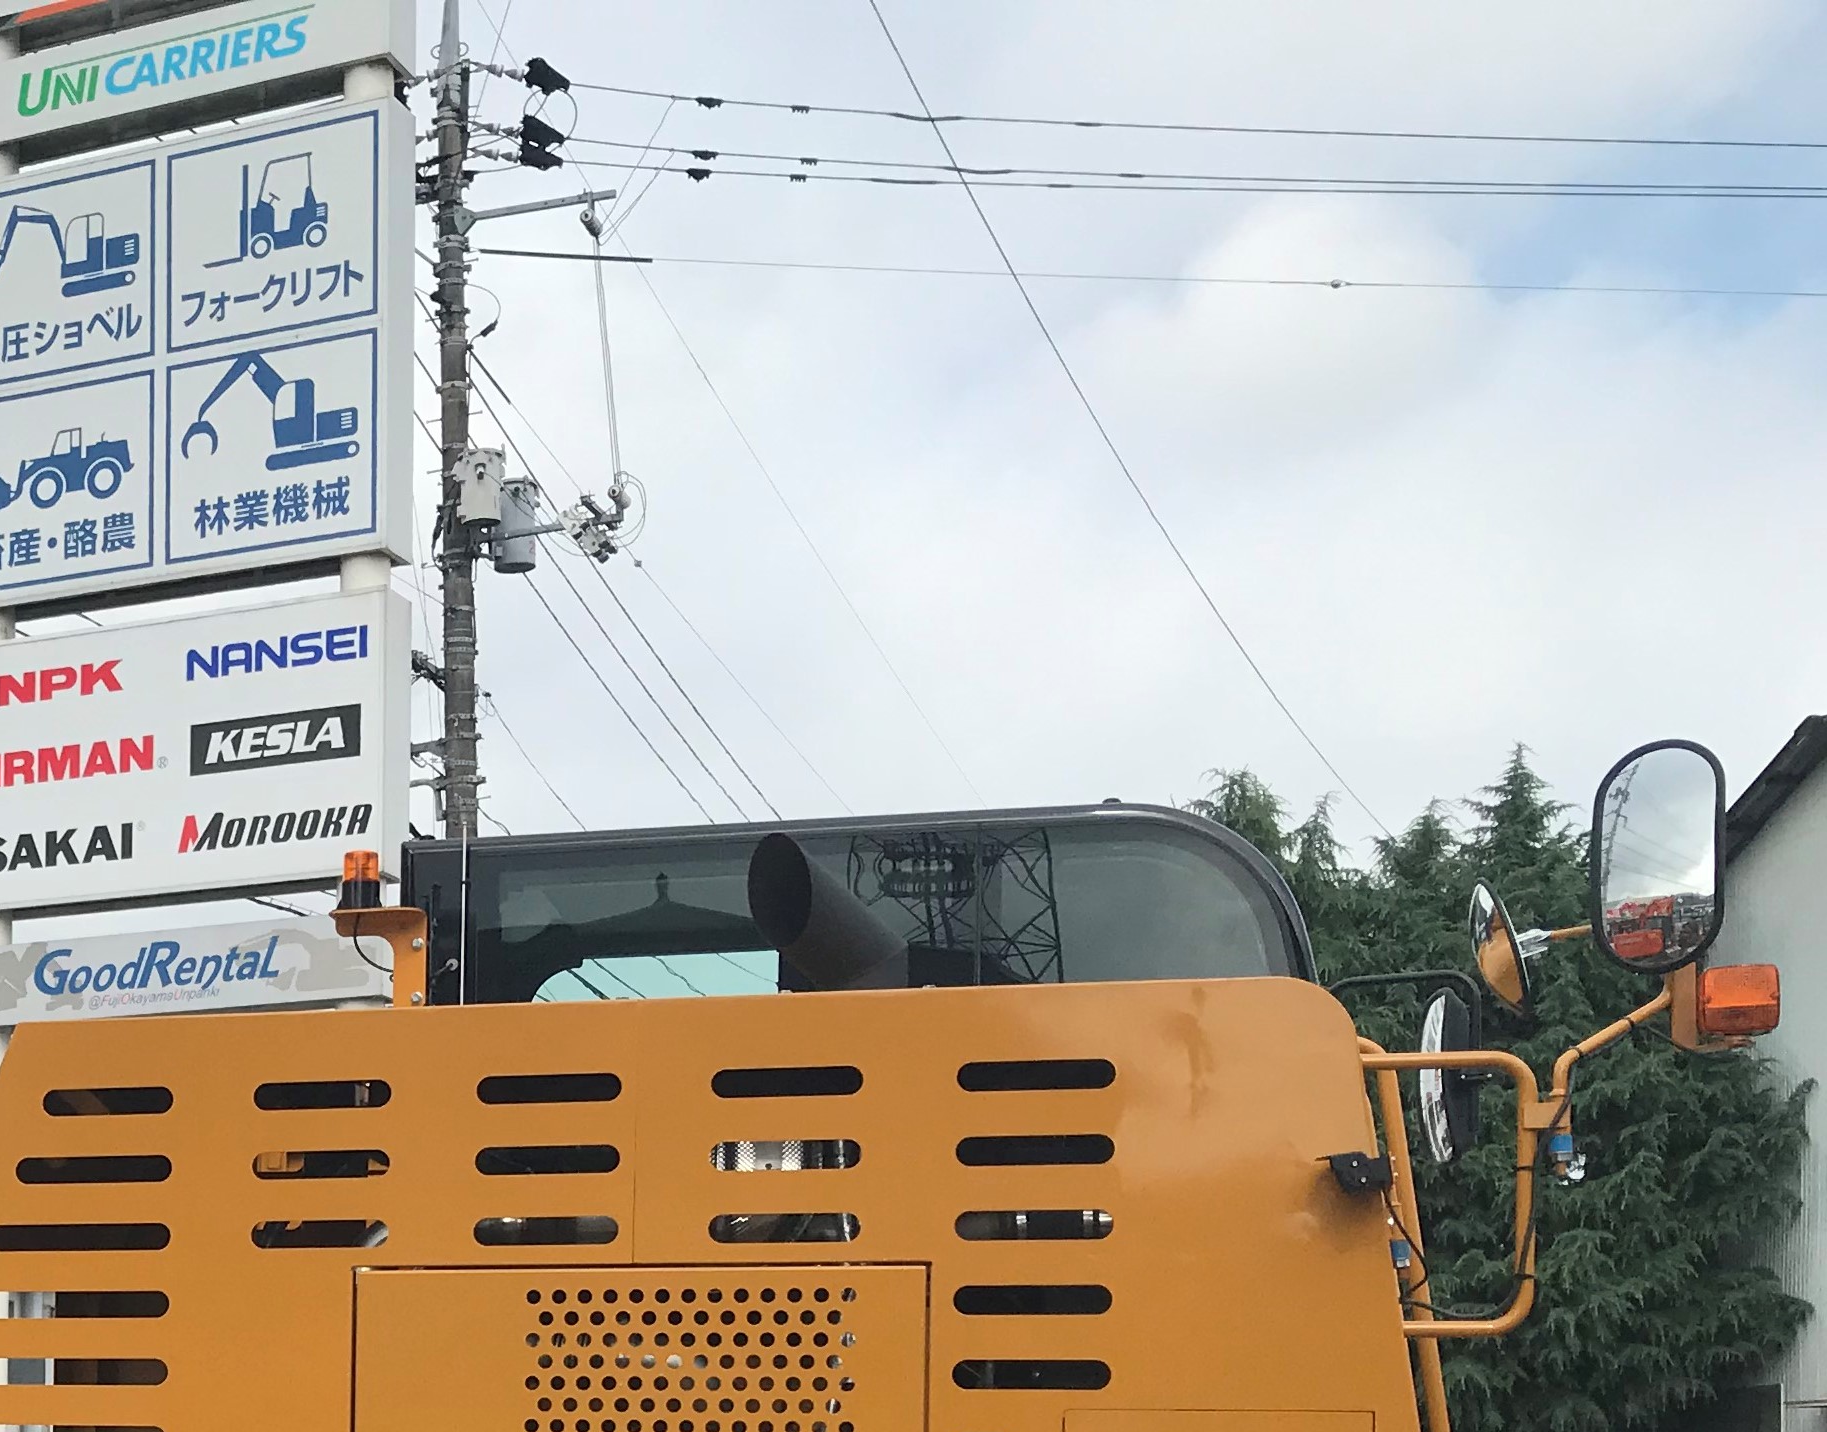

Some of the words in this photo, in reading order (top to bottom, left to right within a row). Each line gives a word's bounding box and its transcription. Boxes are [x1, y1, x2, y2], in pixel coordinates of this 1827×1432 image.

[181, 260, 365, 328] フォークリフト
[194, 476, 352, 539] 林業機械
[186, 625, 369, 682] NANSEI
[204, 716, 346, 765] KESLA
[178, 803, 373, 854] MOROOKA
